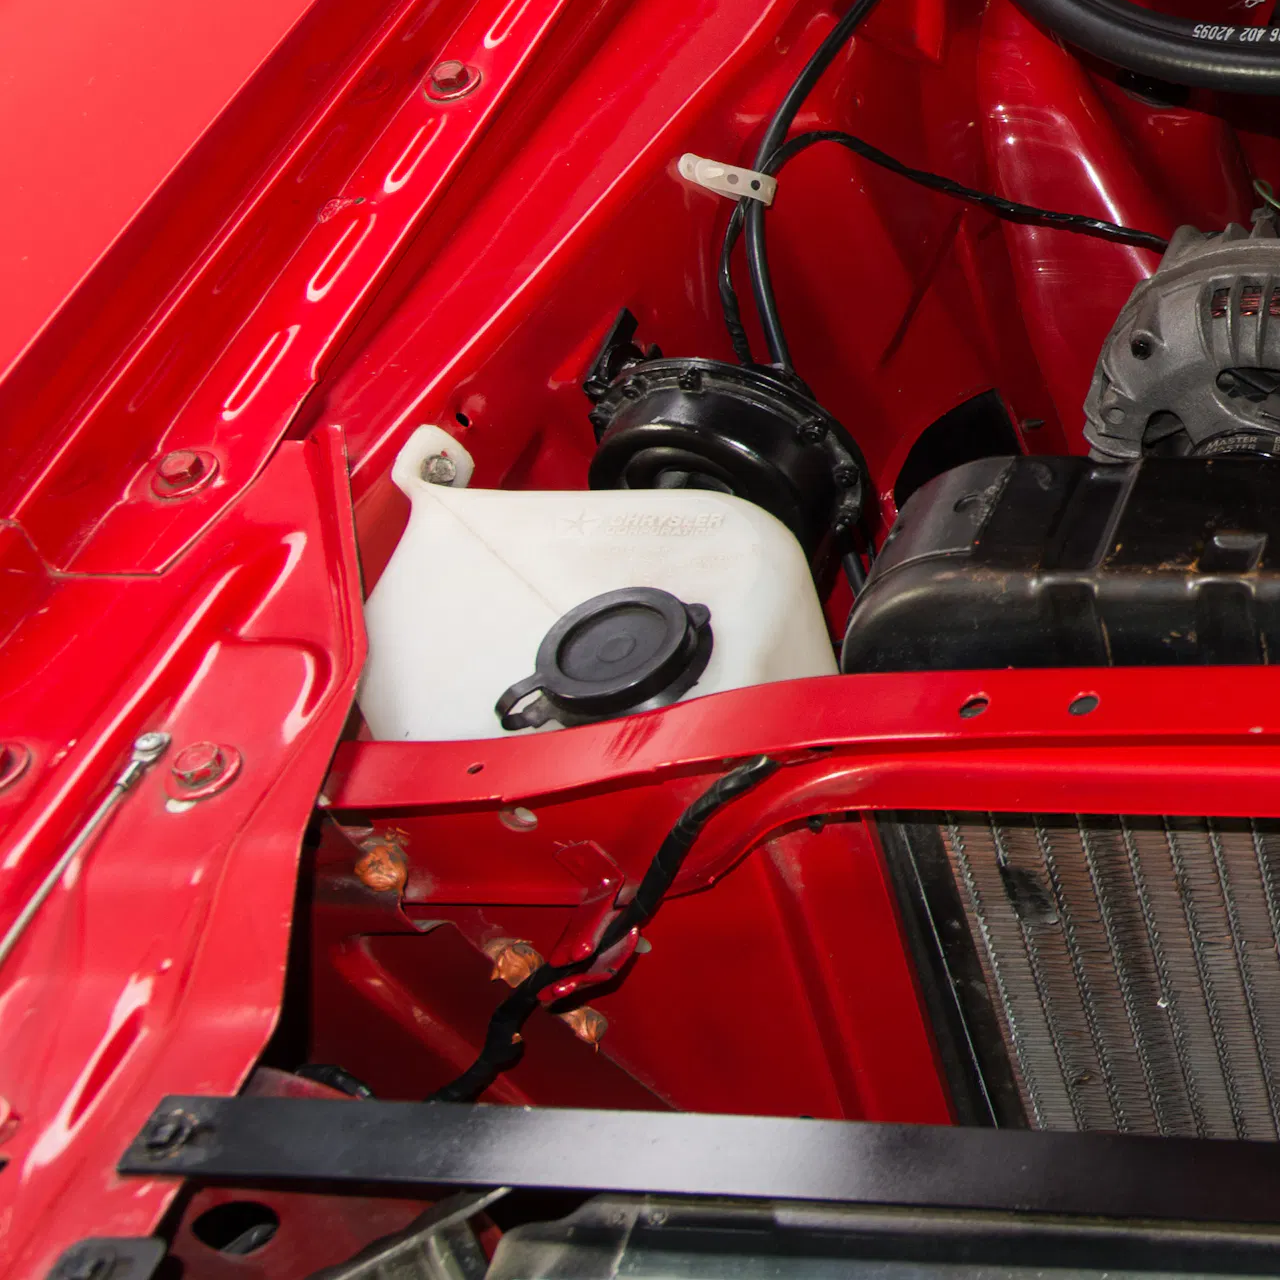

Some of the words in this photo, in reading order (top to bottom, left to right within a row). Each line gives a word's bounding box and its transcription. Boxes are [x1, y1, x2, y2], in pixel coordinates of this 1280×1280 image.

[1191, 23, 1236, 41] 42095
[1239, 26, 1267, 42] 402
[1206, 436, 1257, 451] MASTER
[610, 513, 727, 528] CHRYSLER
